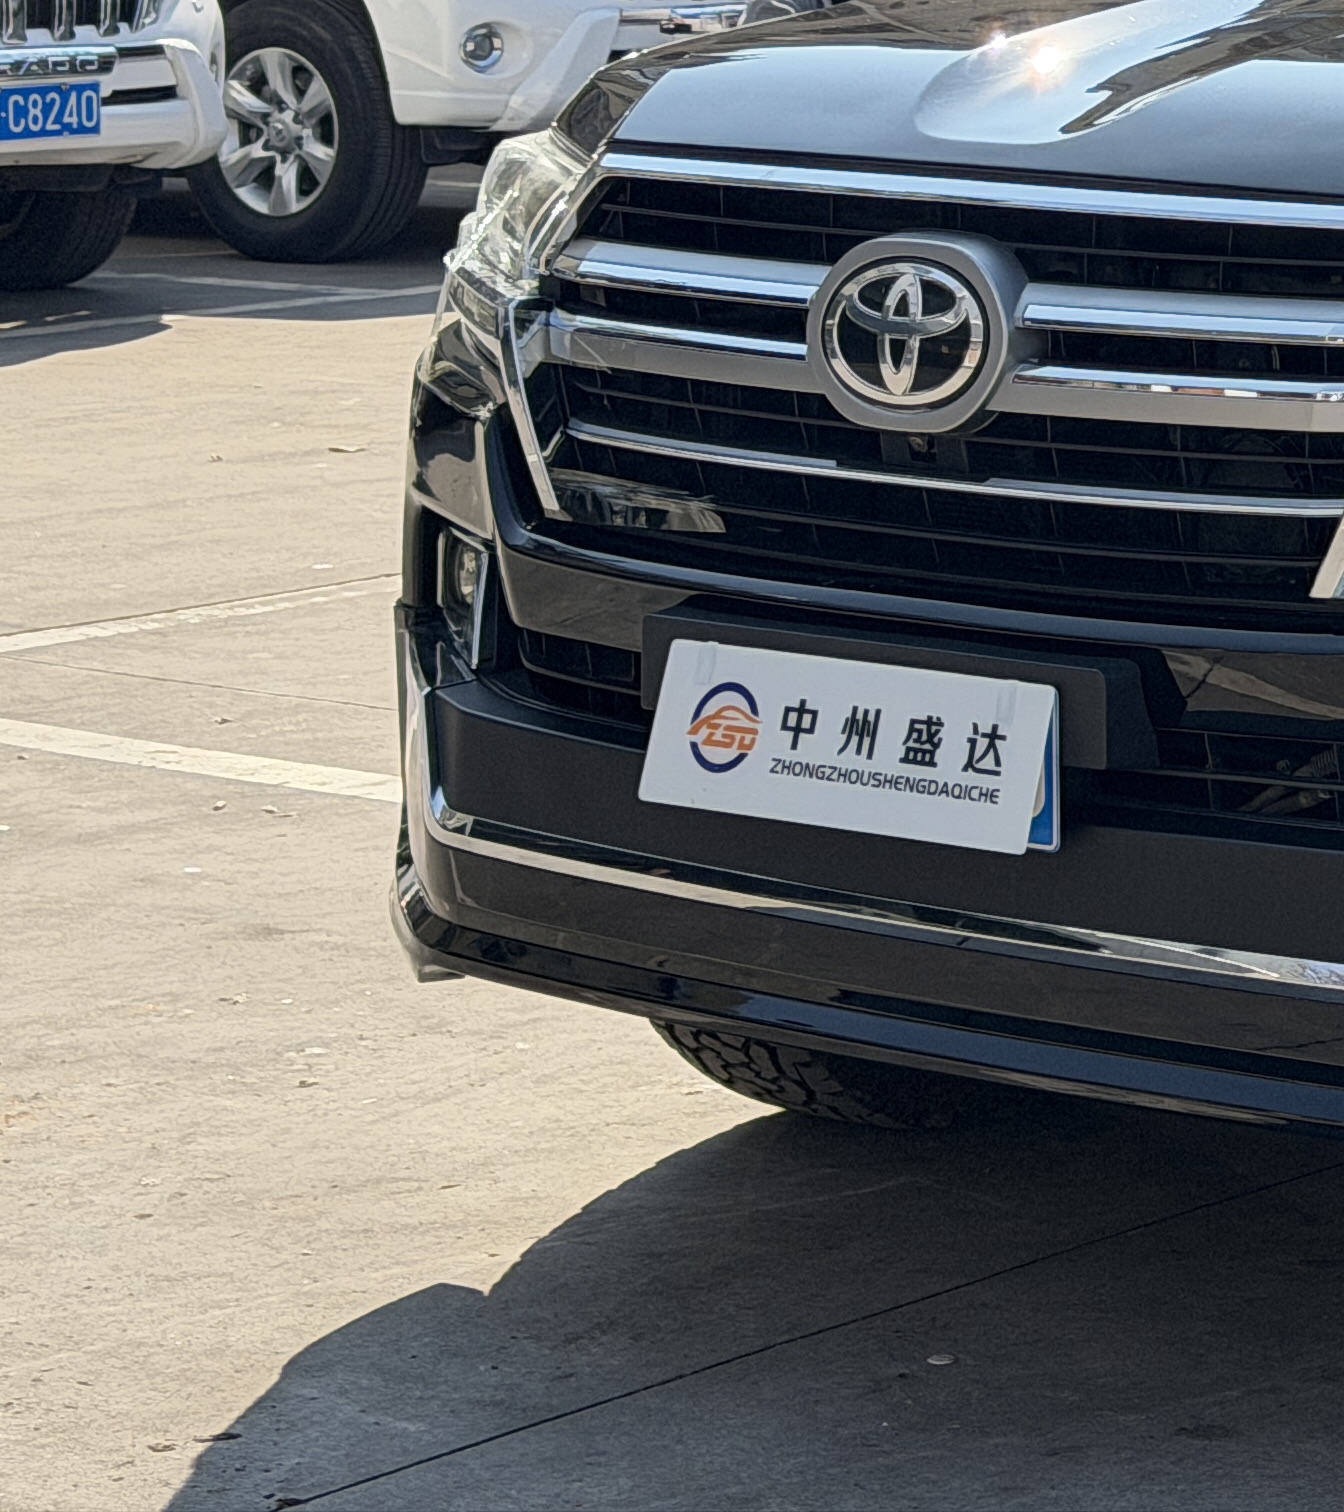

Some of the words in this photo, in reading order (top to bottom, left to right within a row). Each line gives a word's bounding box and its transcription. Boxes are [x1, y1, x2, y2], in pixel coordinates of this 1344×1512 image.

[780, 699, 1007, 777] 中州盛达
[769, 757, 1001, 805] ZHONGZHOUSHENGDAQICHE
